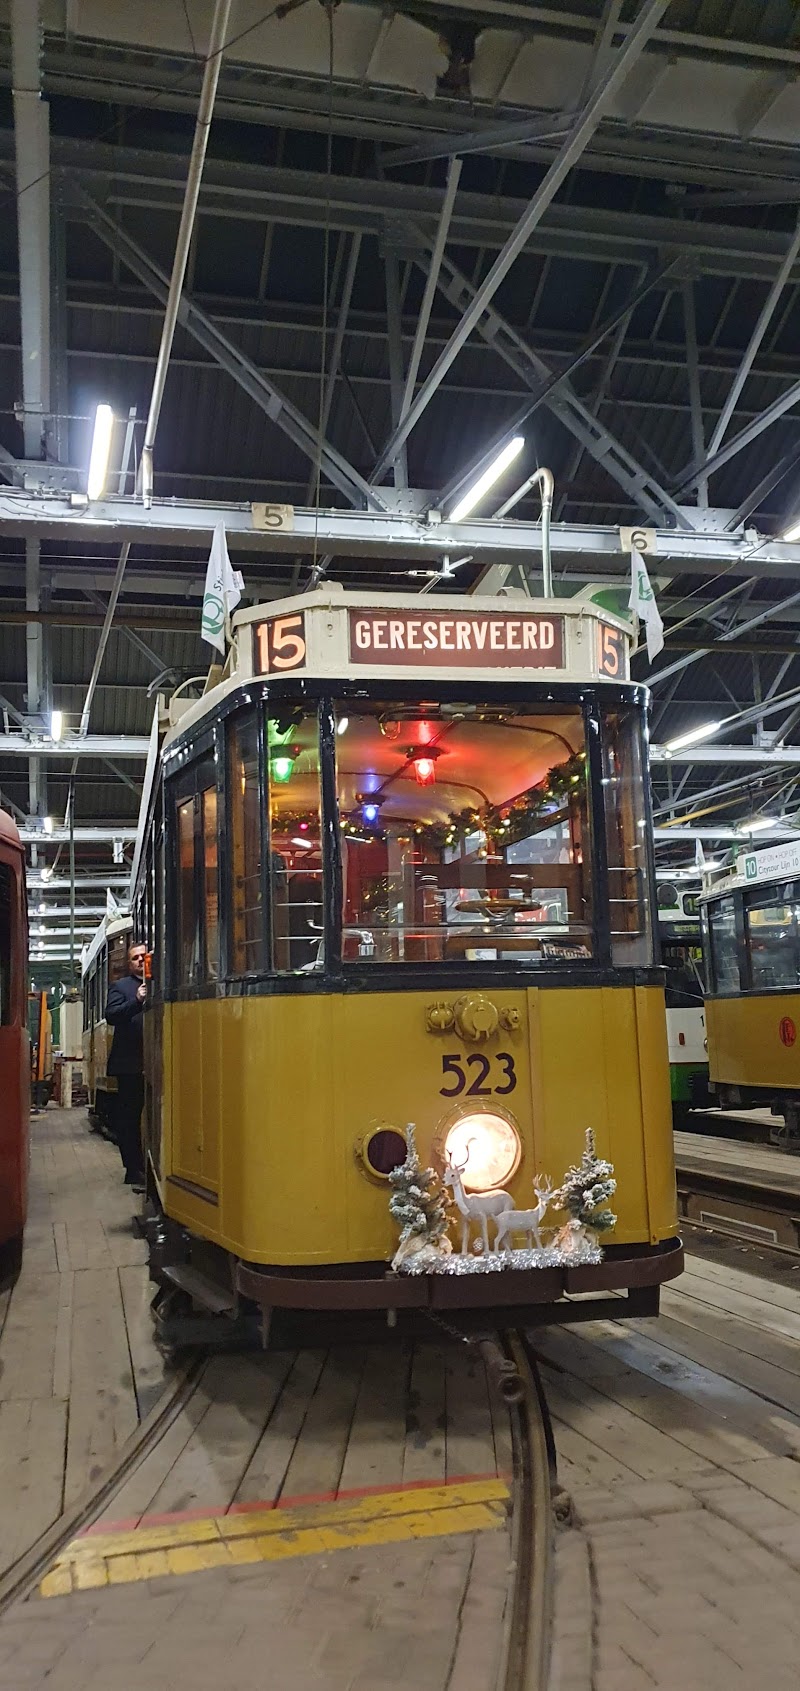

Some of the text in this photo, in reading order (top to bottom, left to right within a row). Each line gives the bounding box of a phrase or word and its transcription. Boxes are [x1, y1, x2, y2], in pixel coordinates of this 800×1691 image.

[264, 505, 283, 527] 5
[631, 530, 648, 551] 6
[257, 616, 306, 673] 15
[355, 620, 555, 650] GERESERVEERD
[598, 623, 619, 675] 15
[746, 860, 756, 876] 10
[758, 857, 799, 875] Citytour Lijn 10
[439, 1052, 517, 1097] 523
